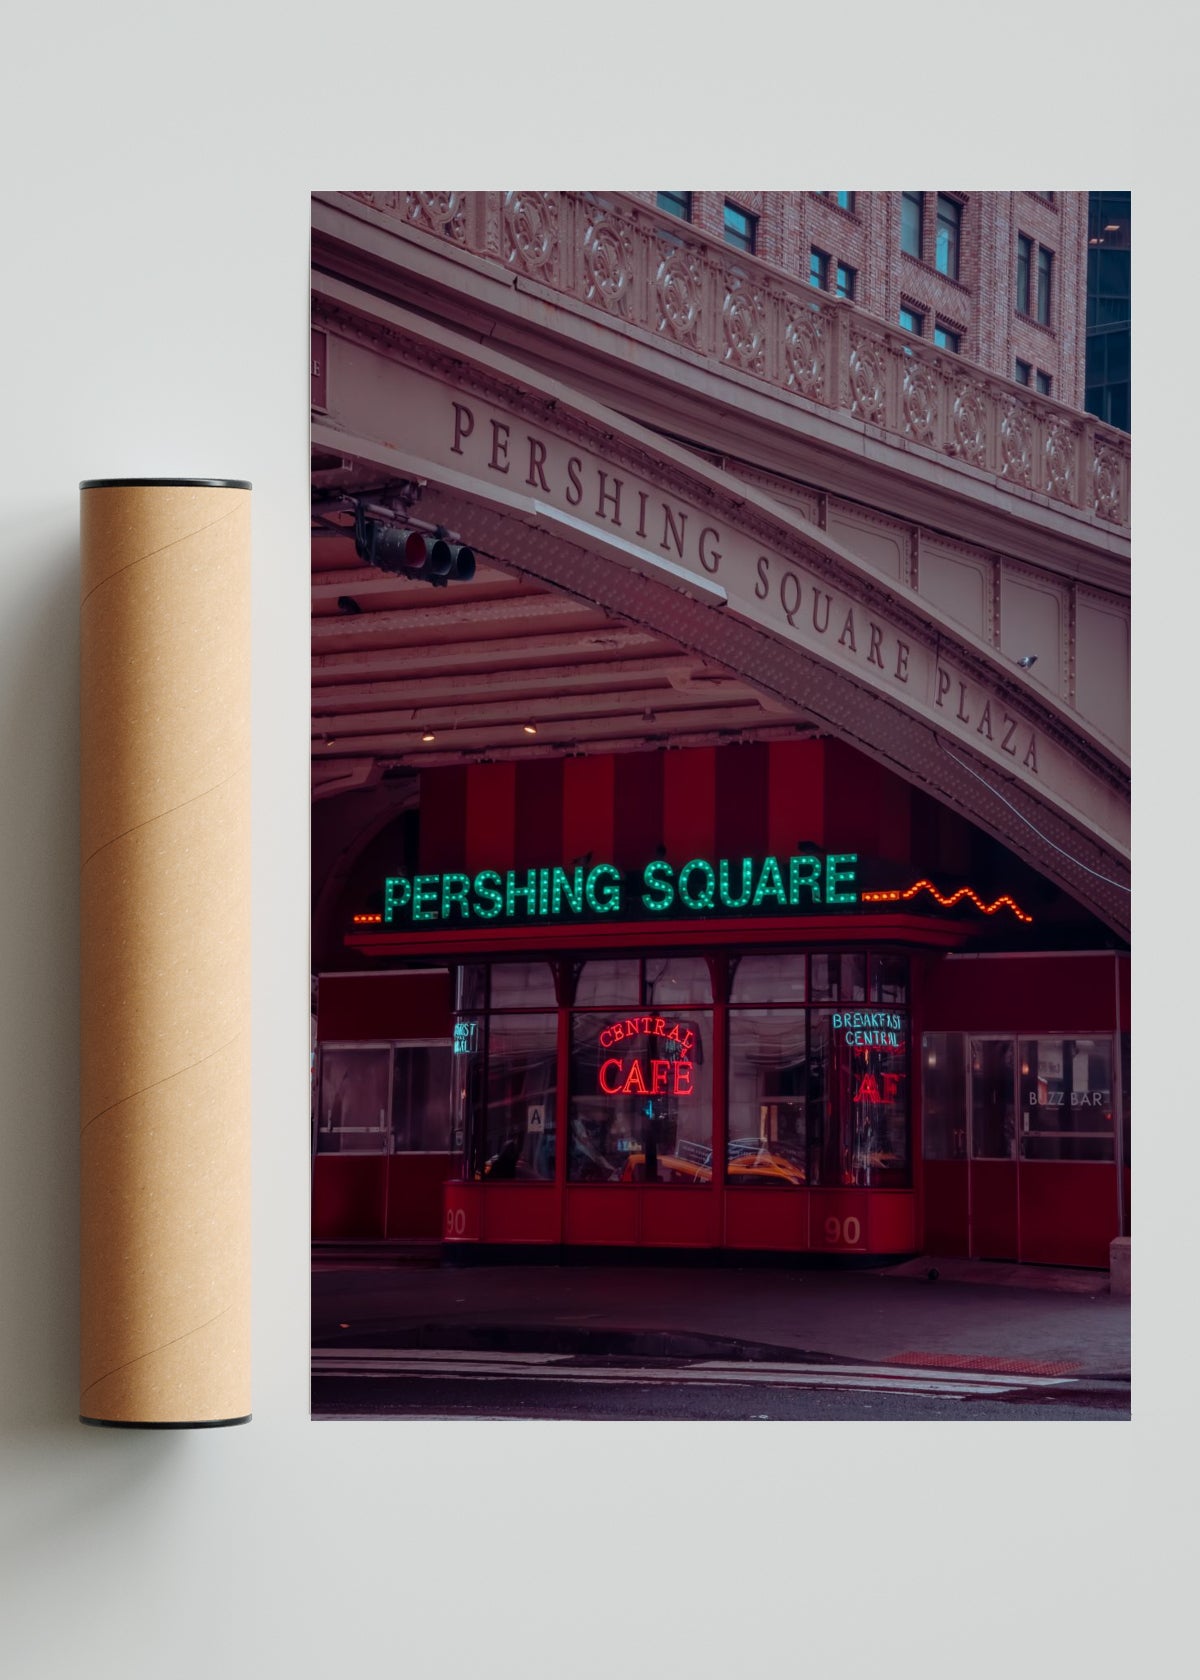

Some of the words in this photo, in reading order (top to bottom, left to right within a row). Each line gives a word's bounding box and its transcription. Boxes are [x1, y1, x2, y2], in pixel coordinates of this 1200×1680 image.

[451, 402, 722, 573] PERSHING
[755, 557, 909, 682] SQUARE
[937, 667, 1038, 773] PLAZA
[384, 863, 621, 922] PERSHING
[642, 854, 858, 911] SQUARE
[600, 1015, 694, 1048] CENTRAL
[833, 1013, 901, 1029] BREAKFAST
[845, 1031, 899, 1047] CENTRAL
[600, 1058, 693, 1095] CAFE
[1029, 1091, 1064, 1106] BUZZ
[1070, 1092, 1102, 1106] BAR
[530, 1109, 541, 1125] A
[446, 1209, 466, 1234] 90
[825, 1217, 861, 1243] 90
